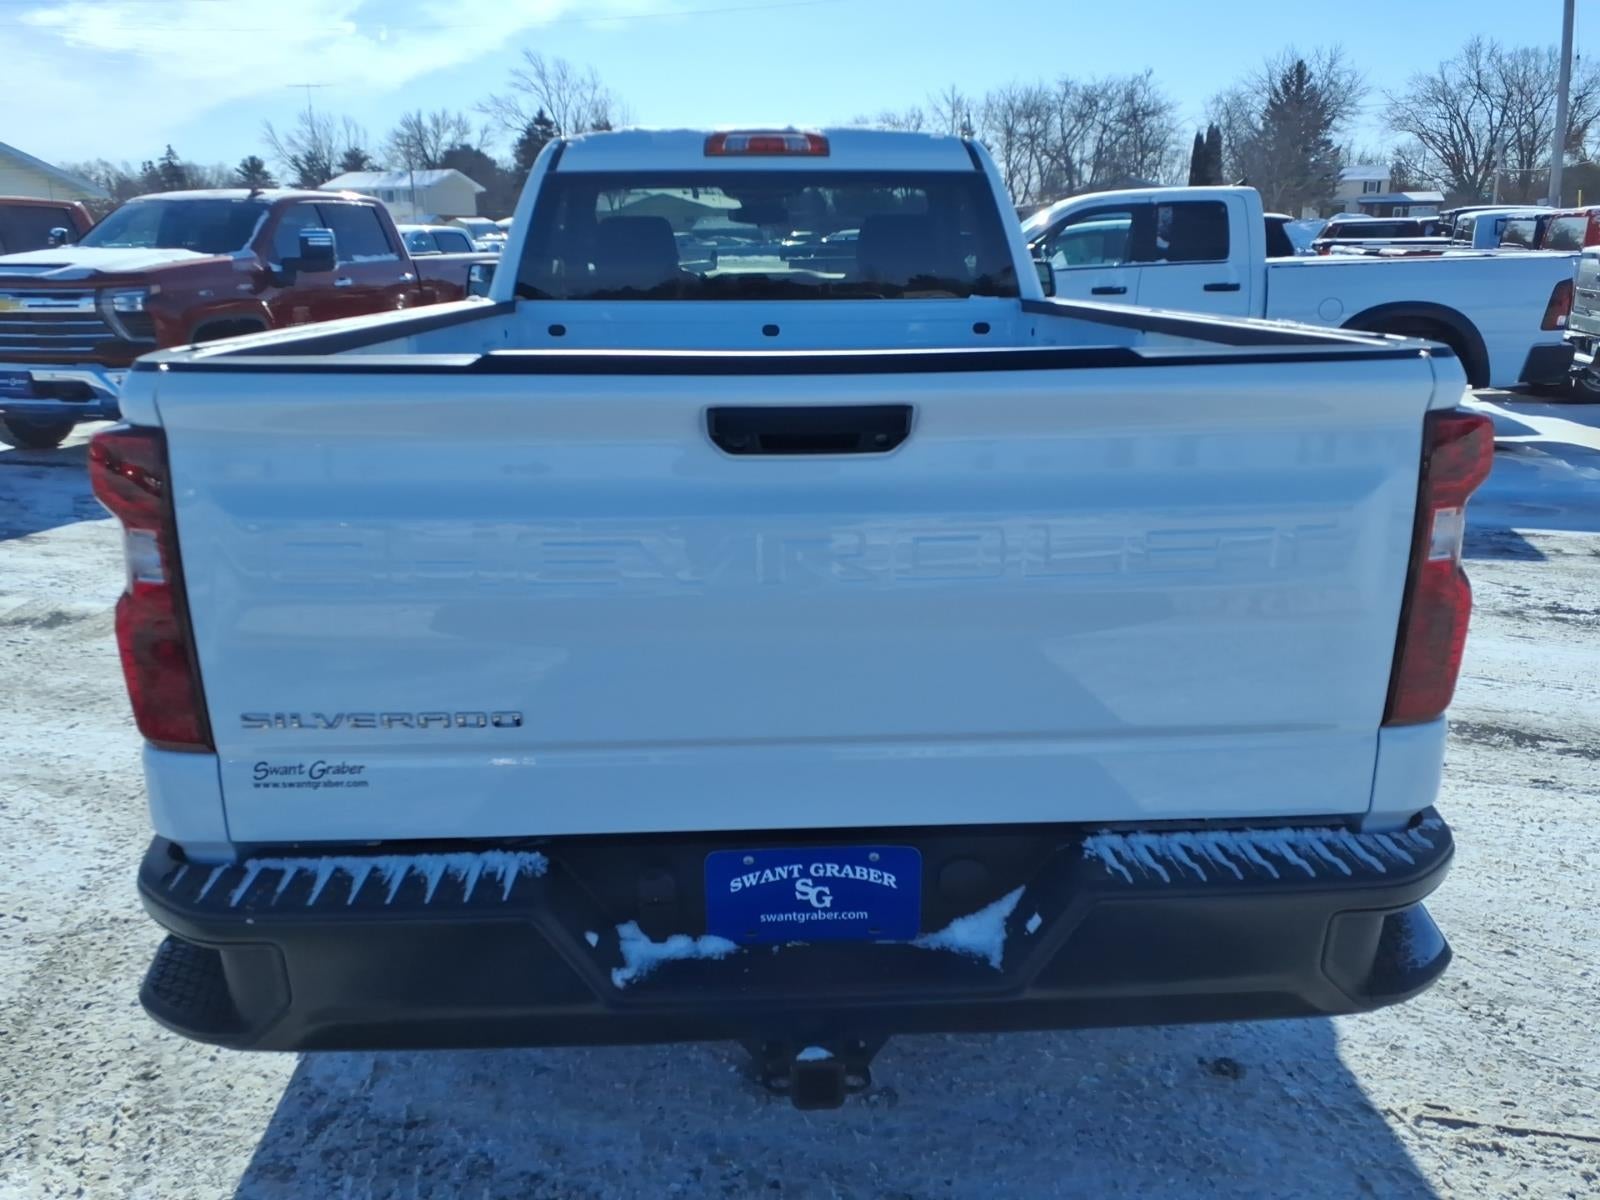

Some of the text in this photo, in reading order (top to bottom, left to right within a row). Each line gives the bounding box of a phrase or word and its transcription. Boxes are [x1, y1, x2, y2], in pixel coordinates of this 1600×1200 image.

[240, 711, 523, 730] SILVERADO
[253, 759, 365, 781] Swant Graber
[253, 779, 369, 790] www.swantgraber.com
[729, 862, 898, 893] SWANT GRABER
[795, 877, 833, 909] SG
[760, 909, 869, 924] swantgraber.com
